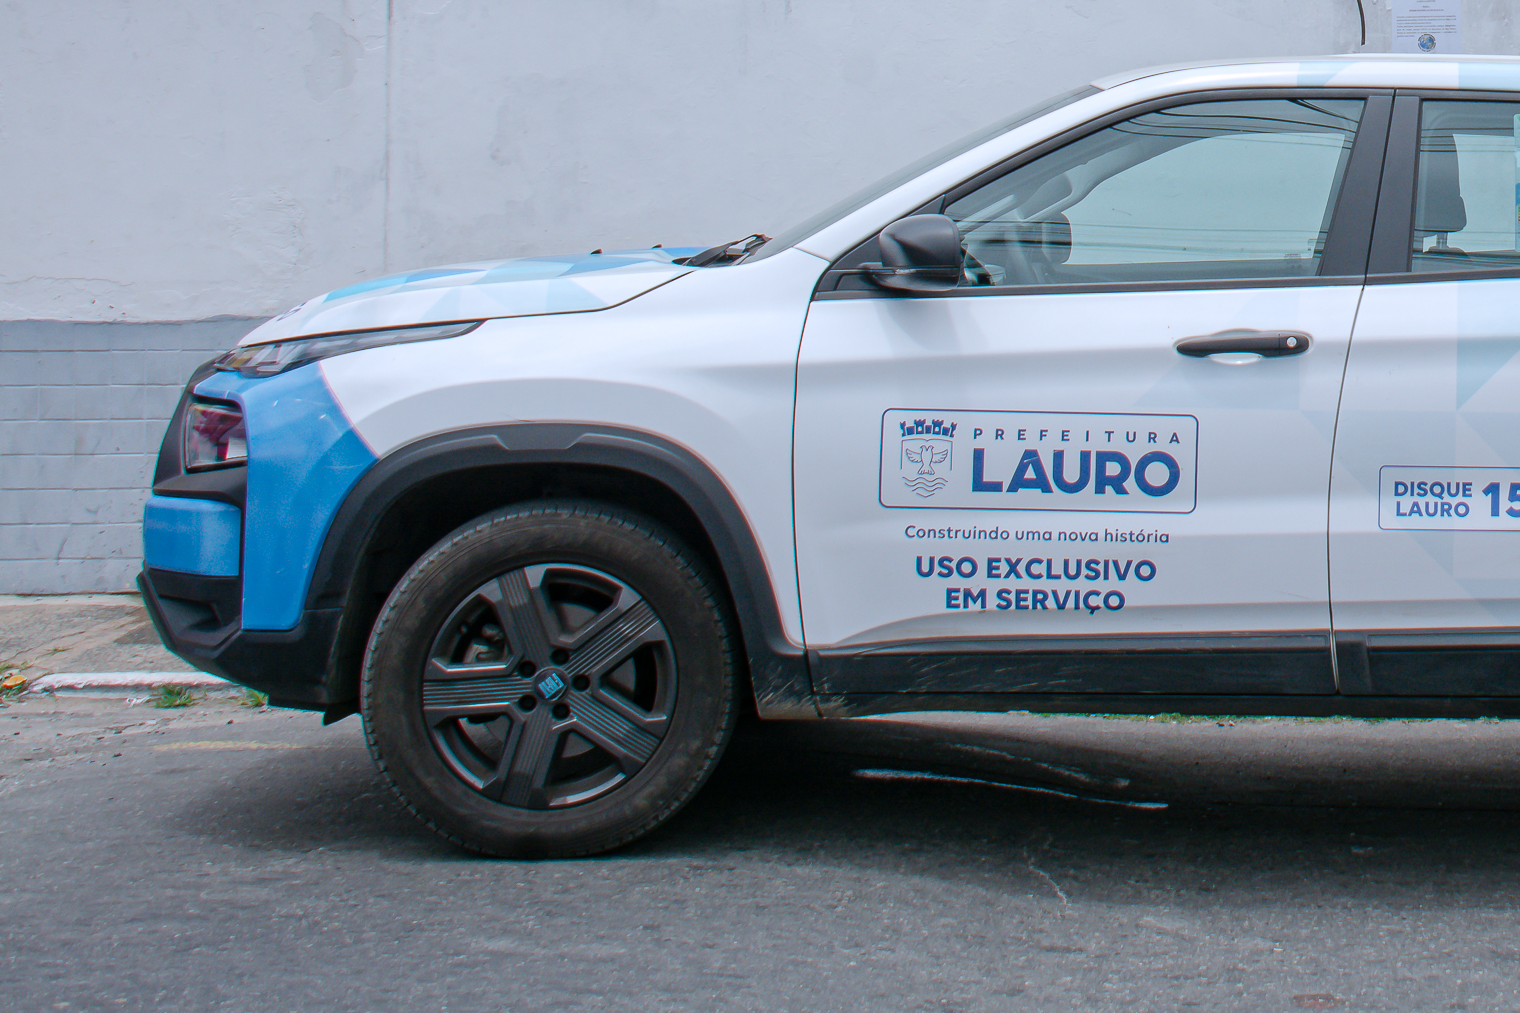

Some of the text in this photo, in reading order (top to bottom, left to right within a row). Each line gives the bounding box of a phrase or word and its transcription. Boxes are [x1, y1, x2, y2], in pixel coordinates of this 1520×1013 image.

[973, 427, 1181, 445] PREFEITURA
[971, 447, 1182, 497] LAURO
[1393, 480, 1473, 500] DISQUE
[1395, 500, 1470, 518] LAURO
[904, 524, 1170, 544] Construindo uma nova história
[915, 555, 1157, 582] USO EXCLUSIVO
[945, 587, 1126, 615] EM SERVIÇO
